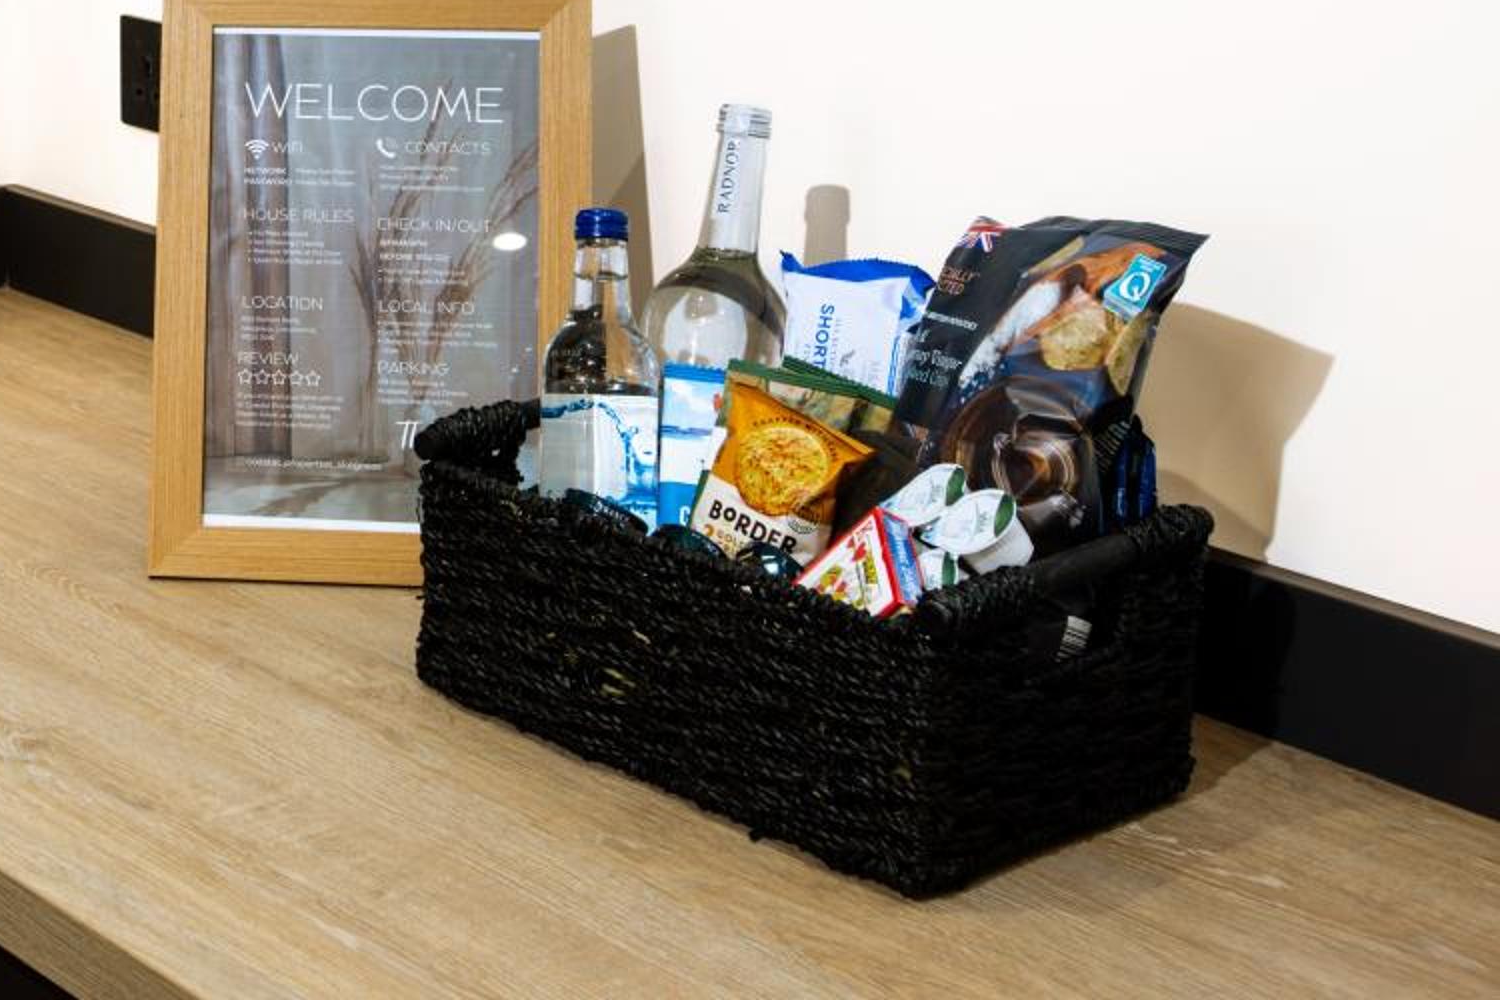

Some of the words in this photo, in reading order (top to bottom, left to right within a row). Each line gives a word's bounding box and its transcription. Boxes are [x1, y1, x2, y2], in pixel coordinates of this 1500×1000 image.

[245, 81, 504, 124] WELCOME
[404, 140, 492, 155] CONTACTS
[717, 140, 739, 214] RADNOR
[243, 207, 298, 221] HOUSE
[302, 208, 355, 222] RULES
[376, 216, 430, 231] CHECK
[435, 217, 492, 233] IN/OUT
[242, 295, 324, 311] LOCATION
[378, 300, 431, 313] LOCAL
[437, 301, 475, 314] INFO
[813, 303, 835, 368] SHORT
[237, 351, 299, 366] REVIEW
[377, 360, 450, 377] PARKING
[708, 499, 798, 553] BORDER
